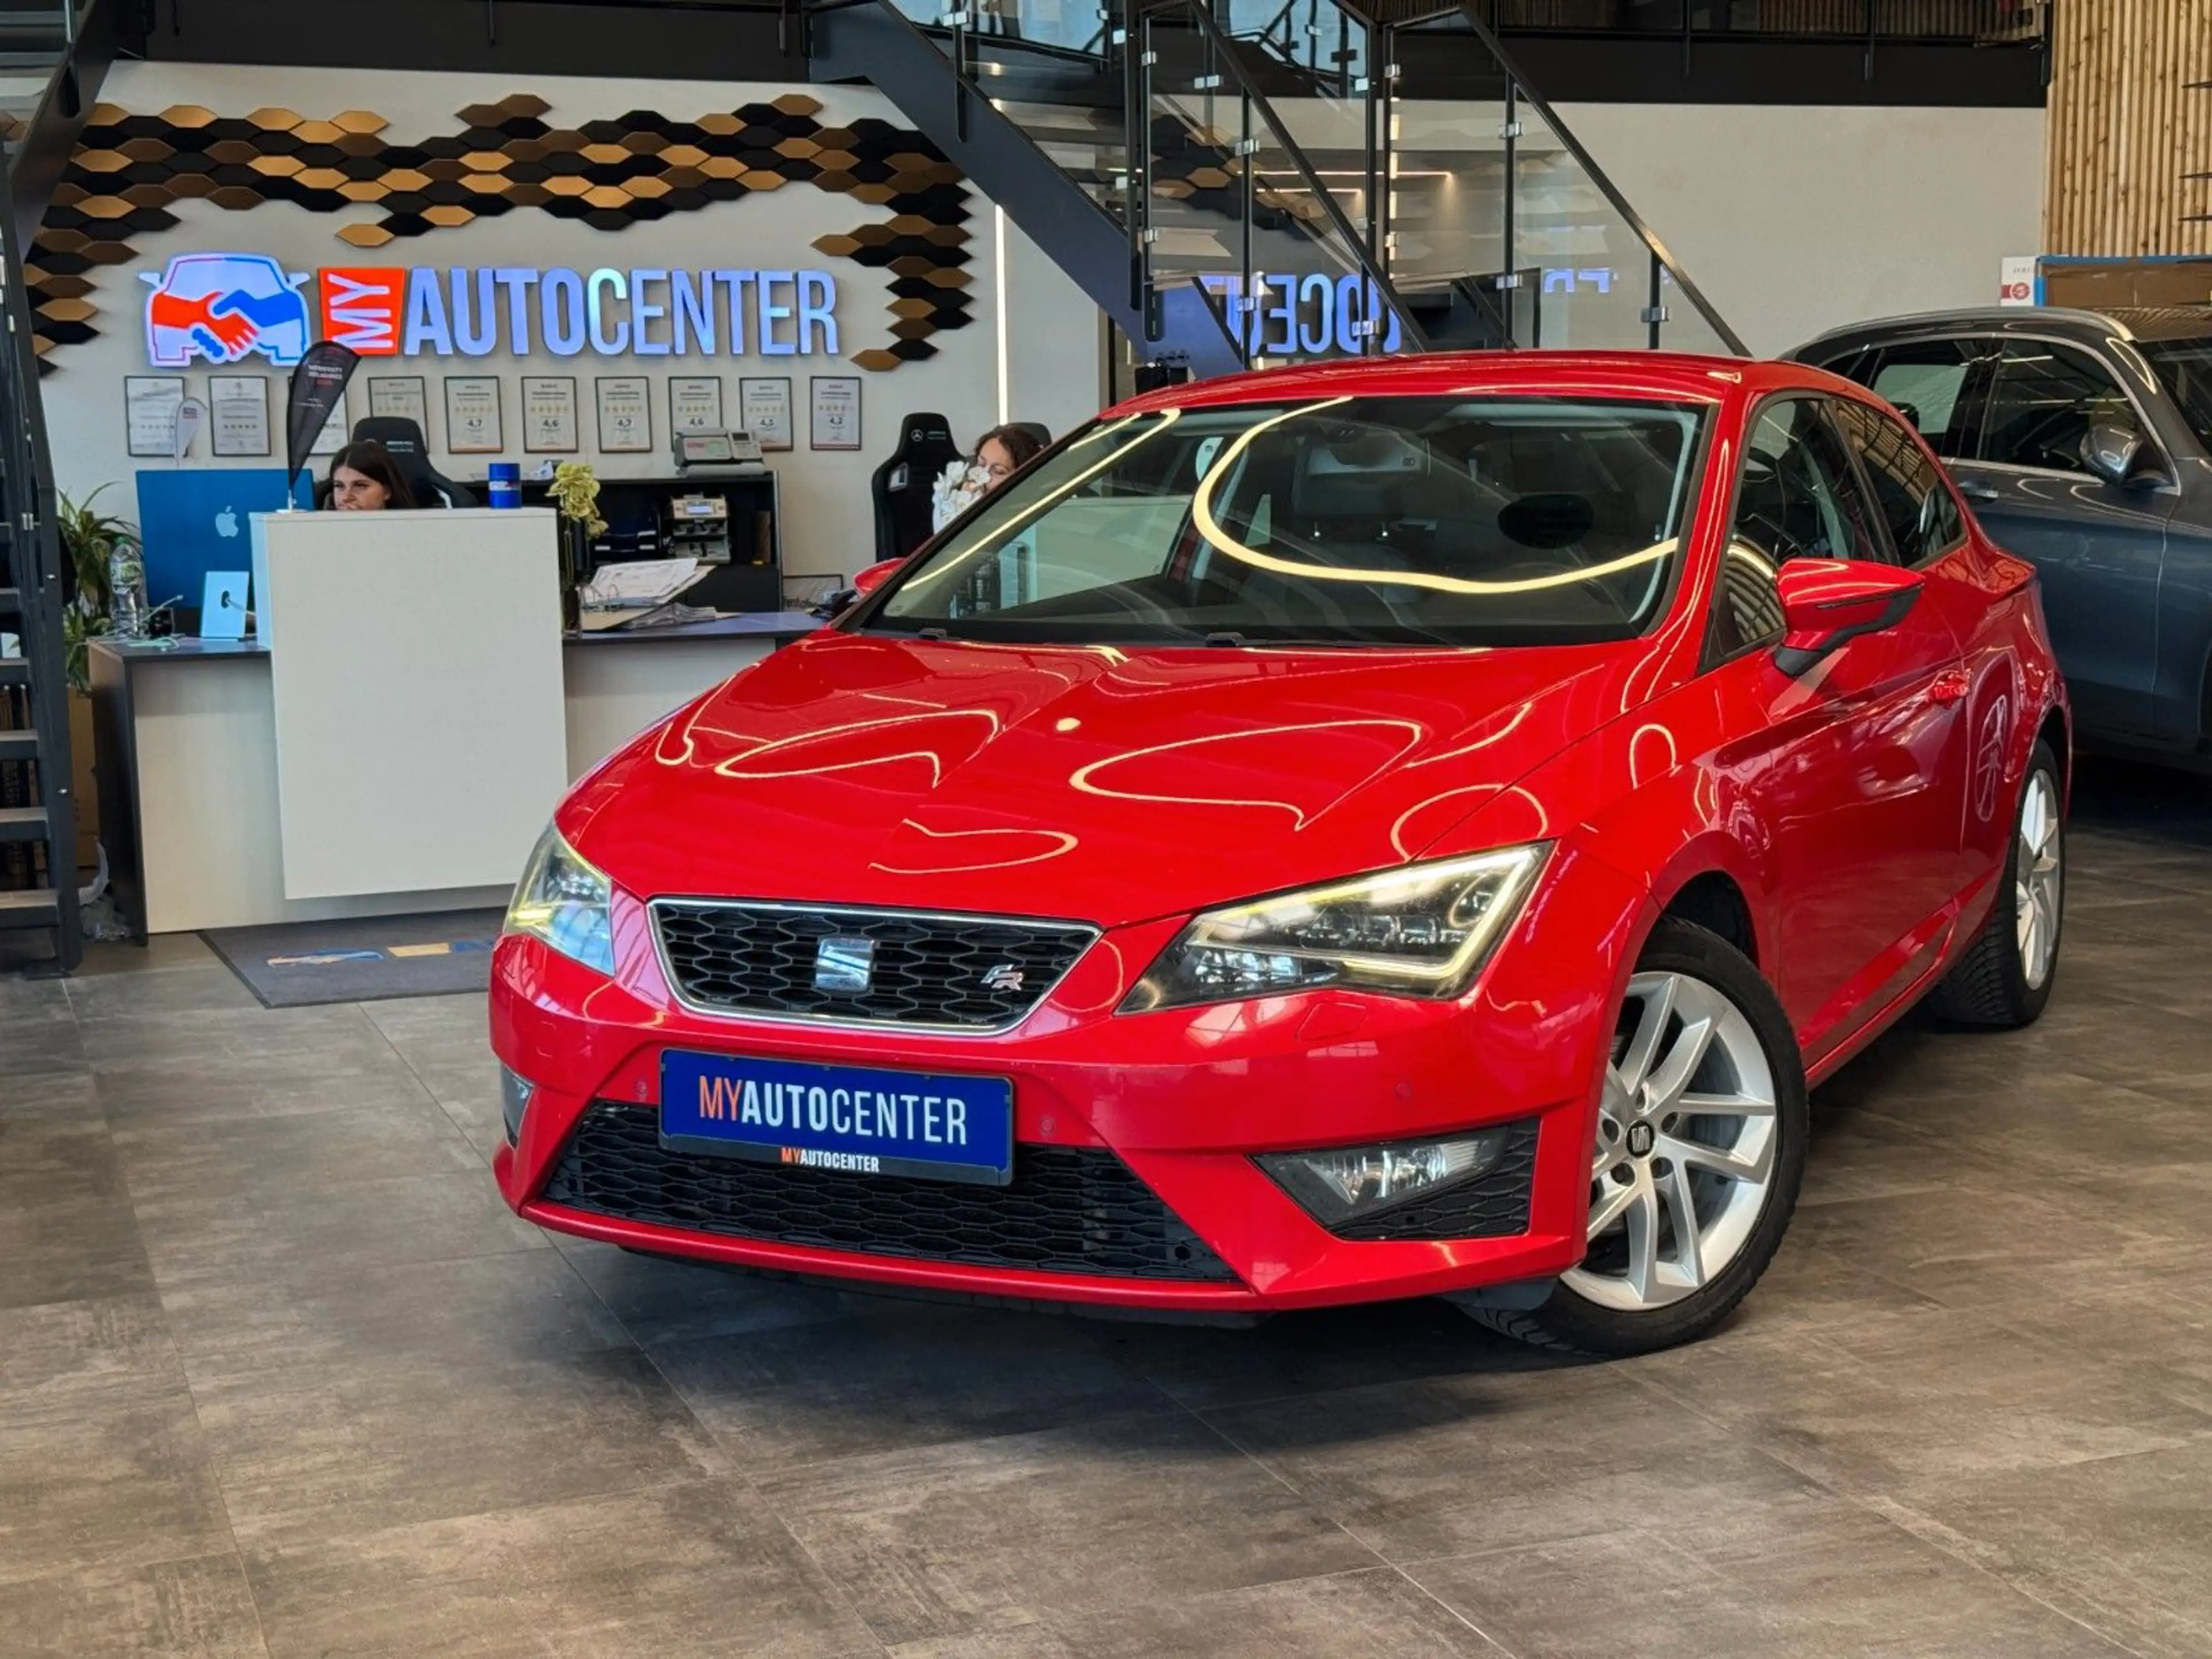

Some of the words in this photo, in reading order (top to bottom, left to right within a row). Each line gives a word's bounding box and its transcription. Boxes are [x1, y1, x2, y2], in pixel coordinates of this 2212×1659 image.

[327, 273, 393, 349] MY
[404, 267, 839, 357] AUTOCENTER
[980, 964, 1023, 990] FR
[698, 1075, 967, 1145] MYAUTOCENTER
